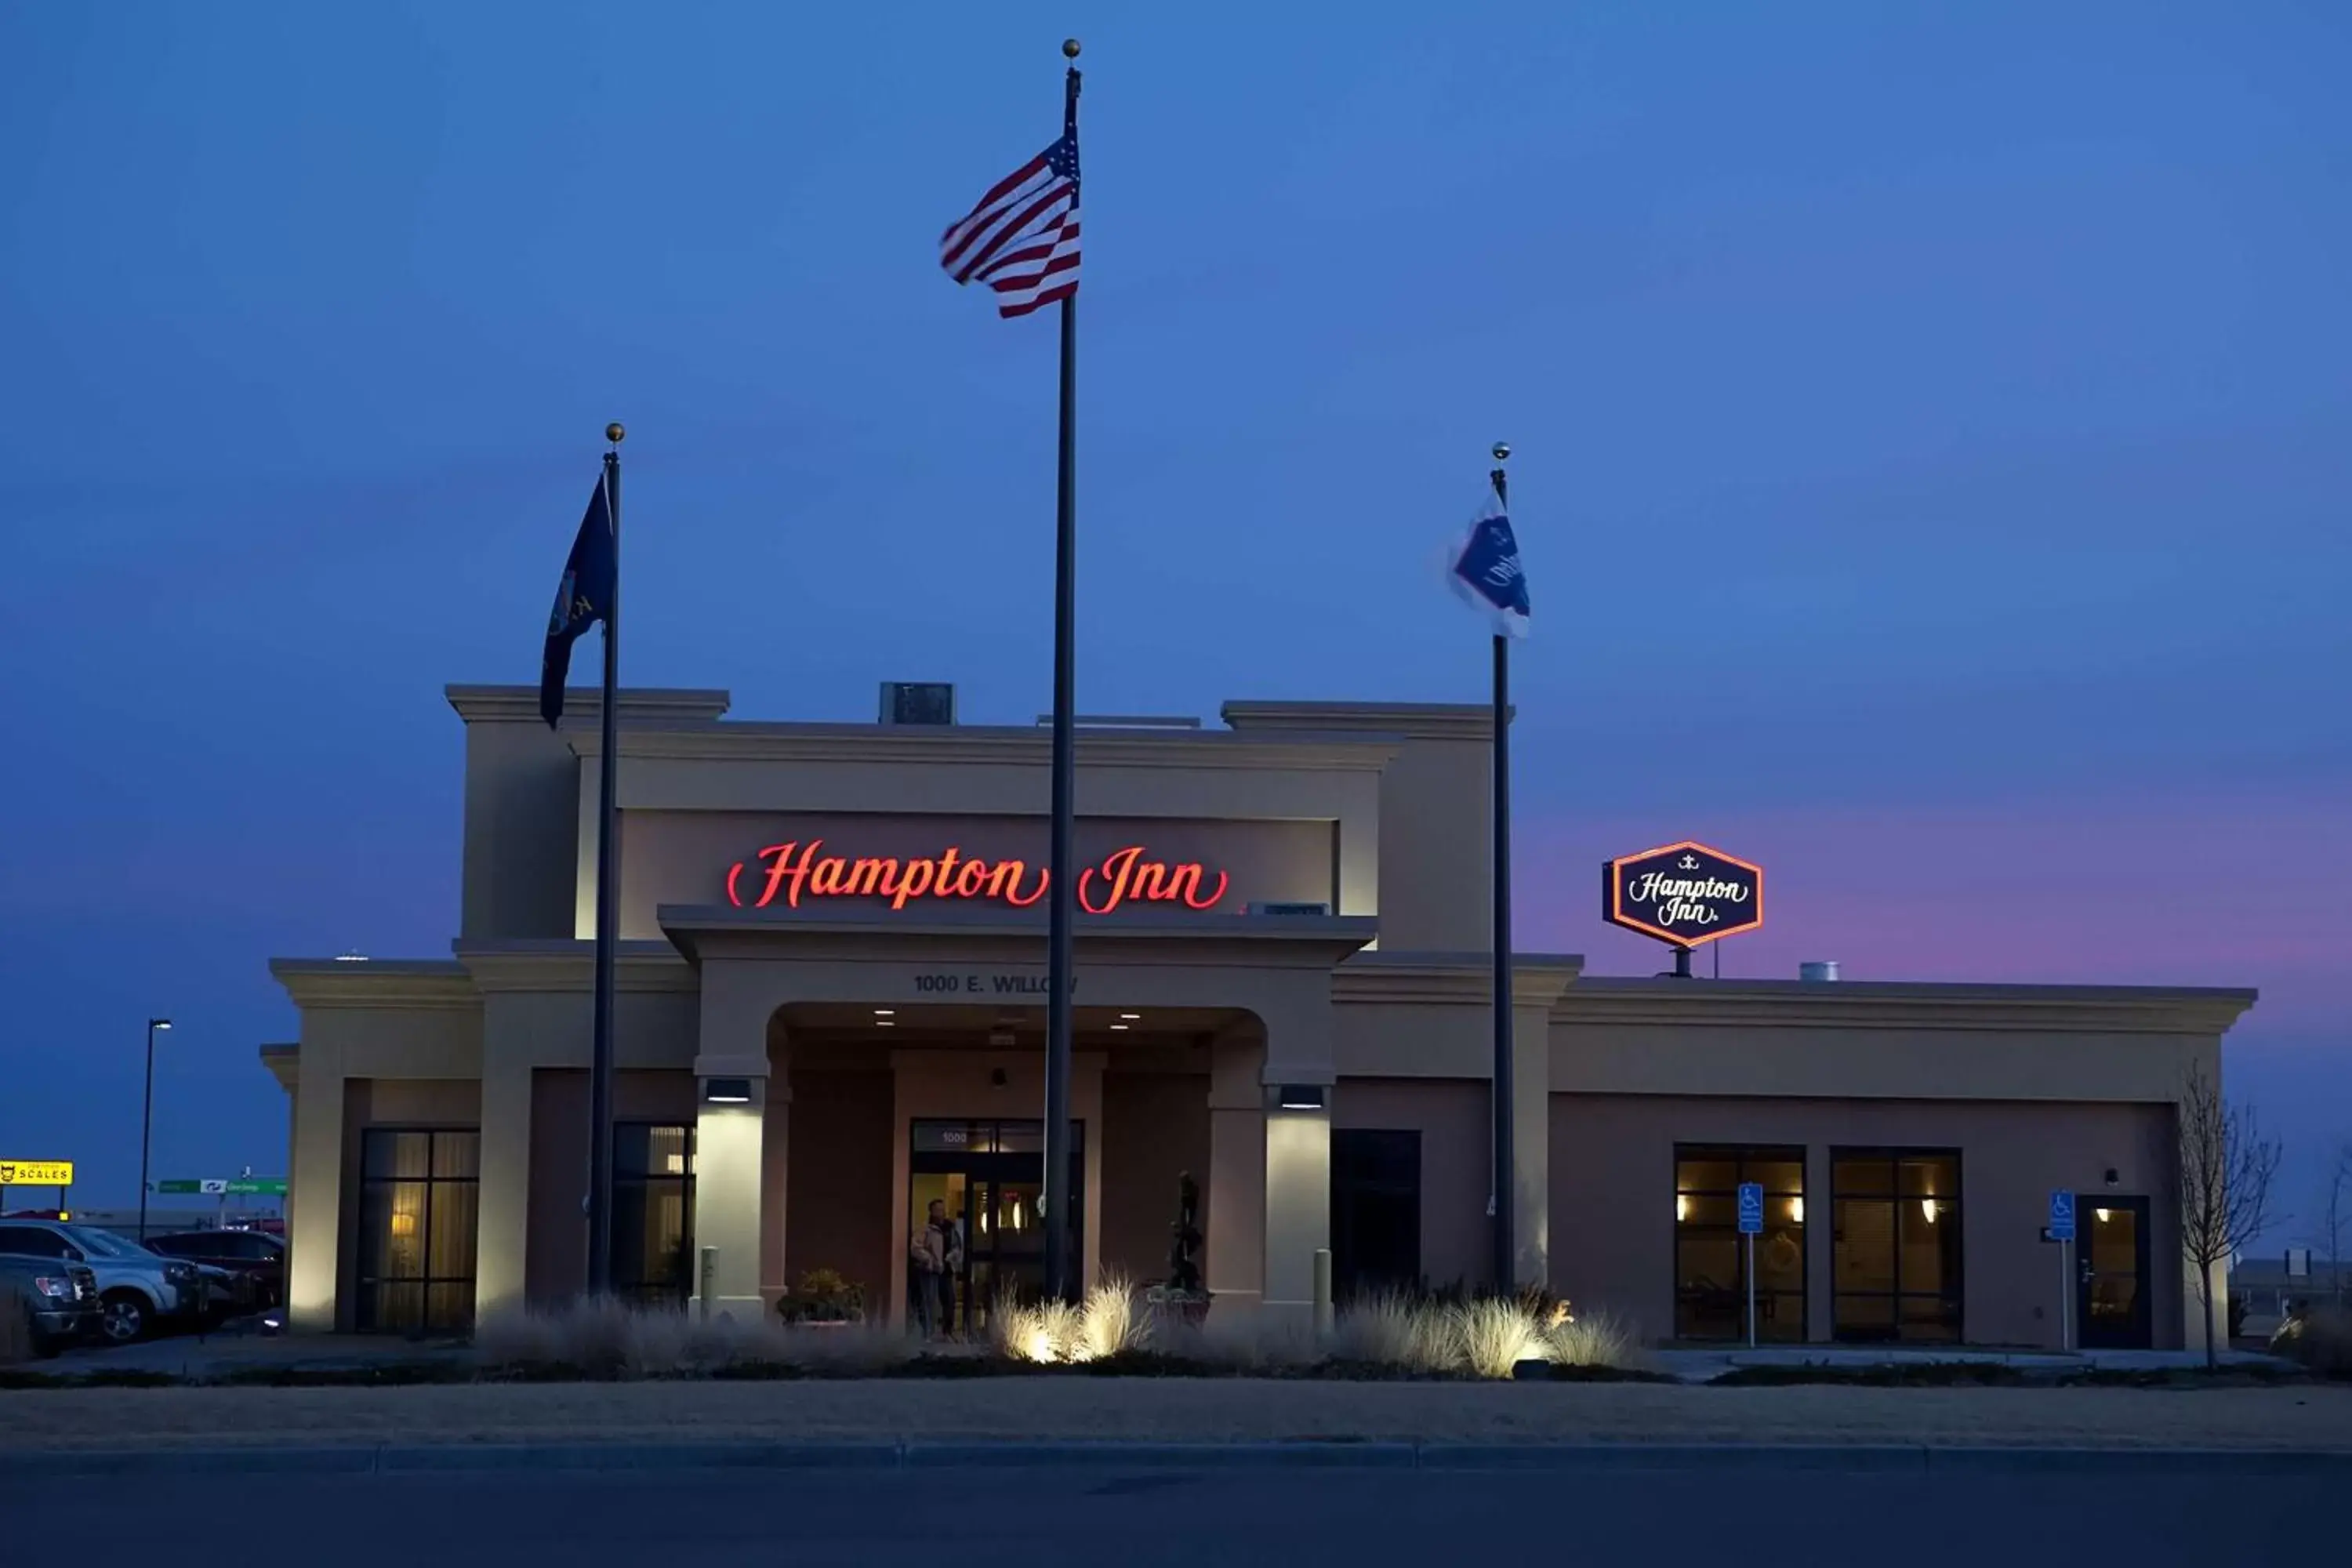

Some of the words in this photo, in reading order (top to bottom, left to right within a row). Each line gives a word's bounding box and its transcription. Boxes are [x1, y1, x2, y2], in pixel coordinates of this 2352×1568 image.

[726, 839, 1050, 910] Hampton
[1078, 846, 1229, 914] Inn
[1628, 871, 1748, 903] Hampton
[1657, 896, 1715, 926] Inn
[914, 975, 958, 993] 1000
[966, 975, 984, 993] E.
[993, 975, 1078, 993] WILL
[943, 1131, 967, 1143] 1000
[19, 1169, 67, 1180] SCALES
